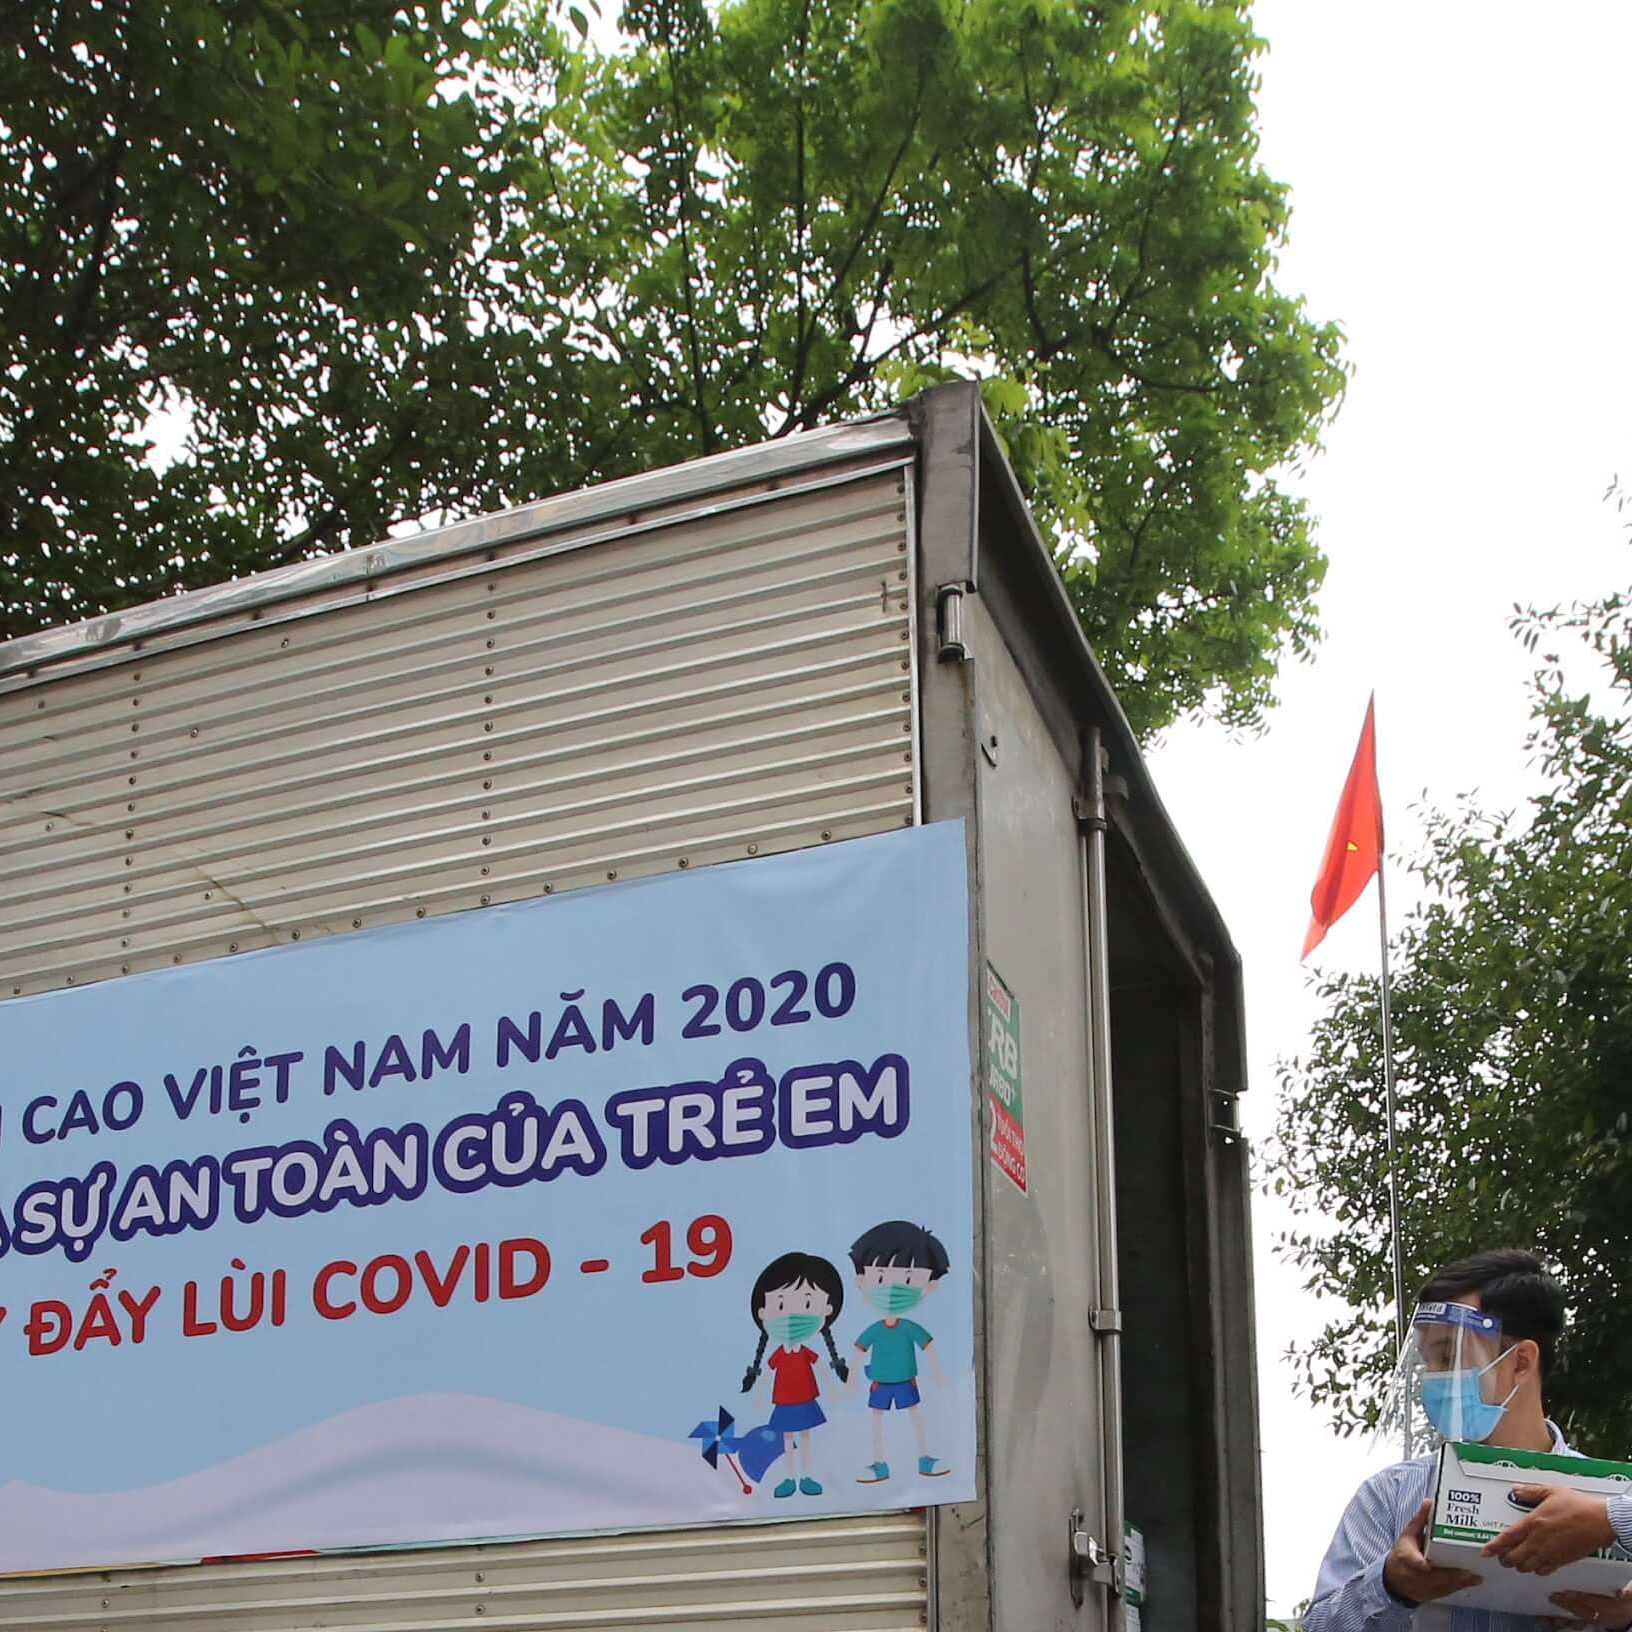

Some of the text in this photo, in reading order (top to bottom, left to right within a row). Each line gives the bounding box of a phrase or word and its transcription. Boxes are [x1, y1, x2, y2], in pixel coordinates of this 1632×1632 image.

[22, 1081, 143, 1144] CAO
[164, 1045, 303, 1124] VIỆT
[323, 1023, 470, 1096] NAM
[496, 988, 654, 1068] NĂM
[681, 962, 856, 1039] 2020
[16, 1166, 111, 1257] SỰ
[115, 1161, 214, 1235] AN
[227, 1124, 422, 1217] TOÀN
[438, 1096, 601, 1187] CỦA
[611, 1063, 769, 1163] TRẺ
[786, 1060, 903, 1143] EM
[24, 1268, 161, 1356] ĐẨY
[183, 1258, 287, 1337] LÙI
[313, 1238, 551, 1319] COVID
[640, 1215, 733, 1283] 19
[1446, 1514, 1478, 1528] Milk
[1447, 1503, 1479, 1515] Fresh
[1450, 1491, 1479, 1503] 100%
